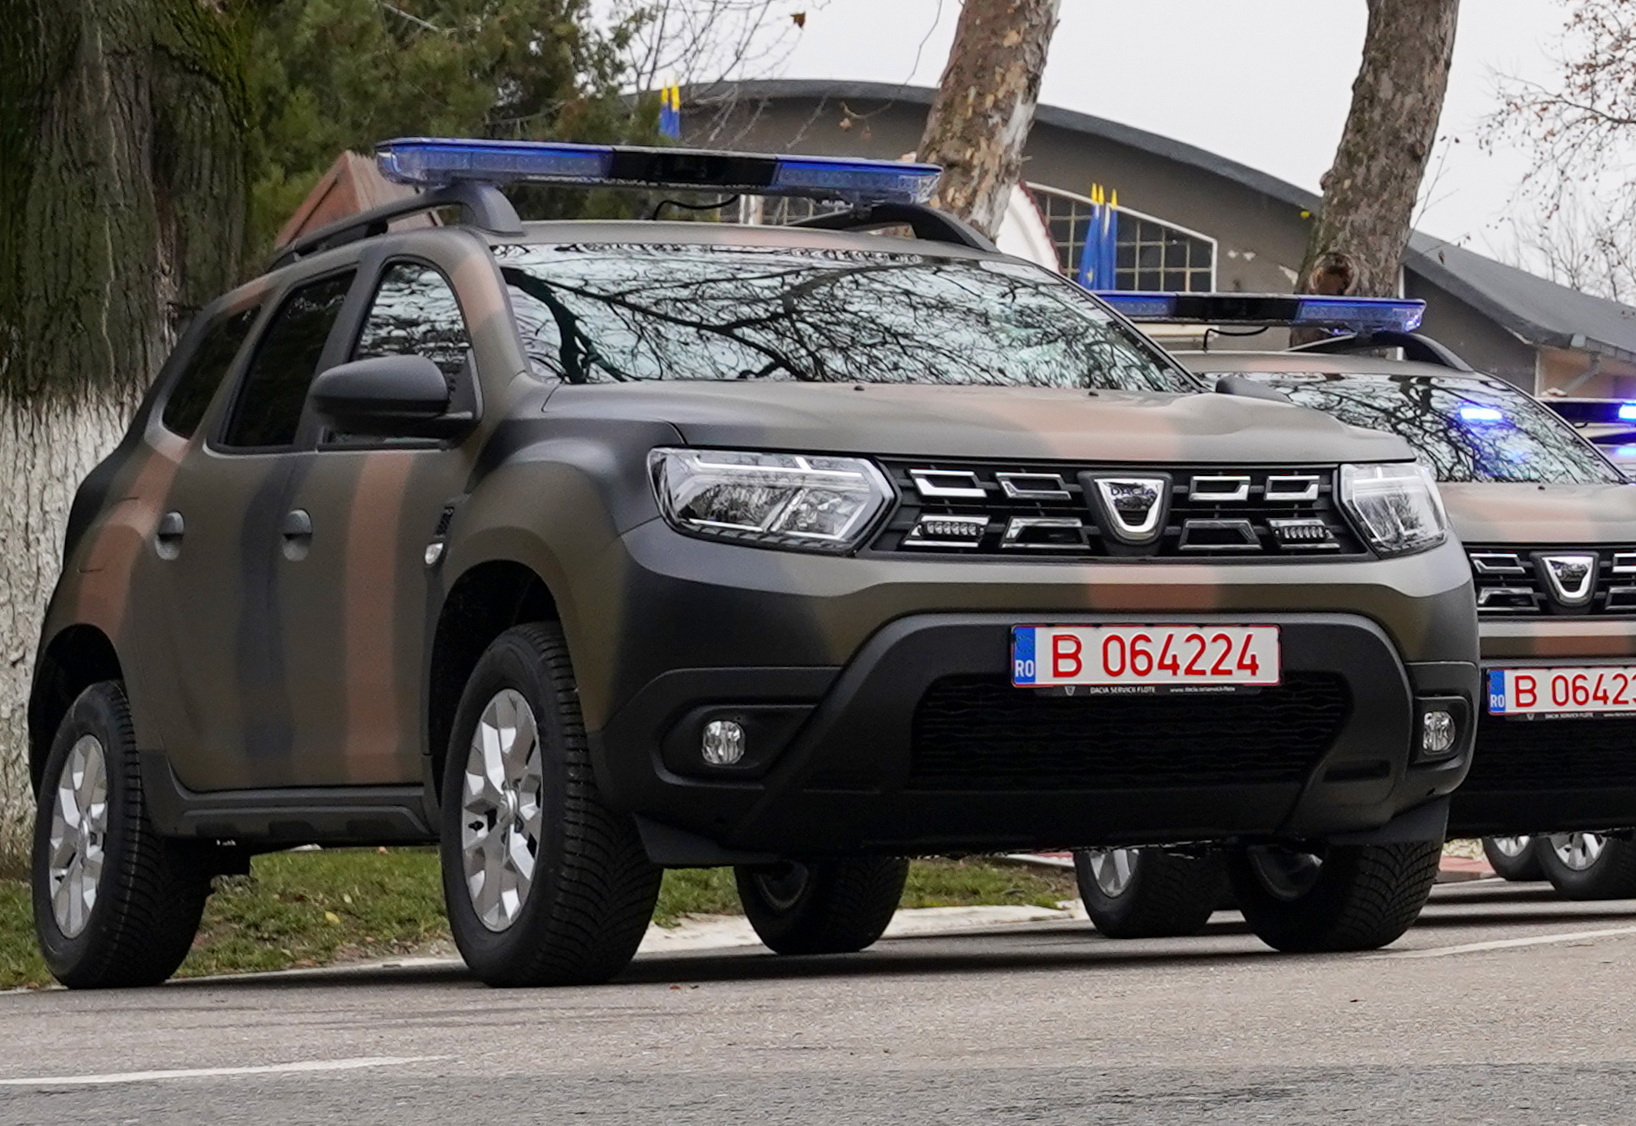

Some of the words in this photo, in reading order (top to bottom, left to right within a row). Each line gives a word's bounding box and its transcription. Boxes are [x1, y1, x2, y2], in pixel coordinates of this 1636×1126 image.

[1111, 486, 1155, 496] DACIA
[1052, 634, 1083, 678] B
[1102, 633, 1259, 677] 064224
[1015, 659, 1034, 677] RO
[1515, 675, 1537, 707] B
[1490, 694, 1505, 708] RO
